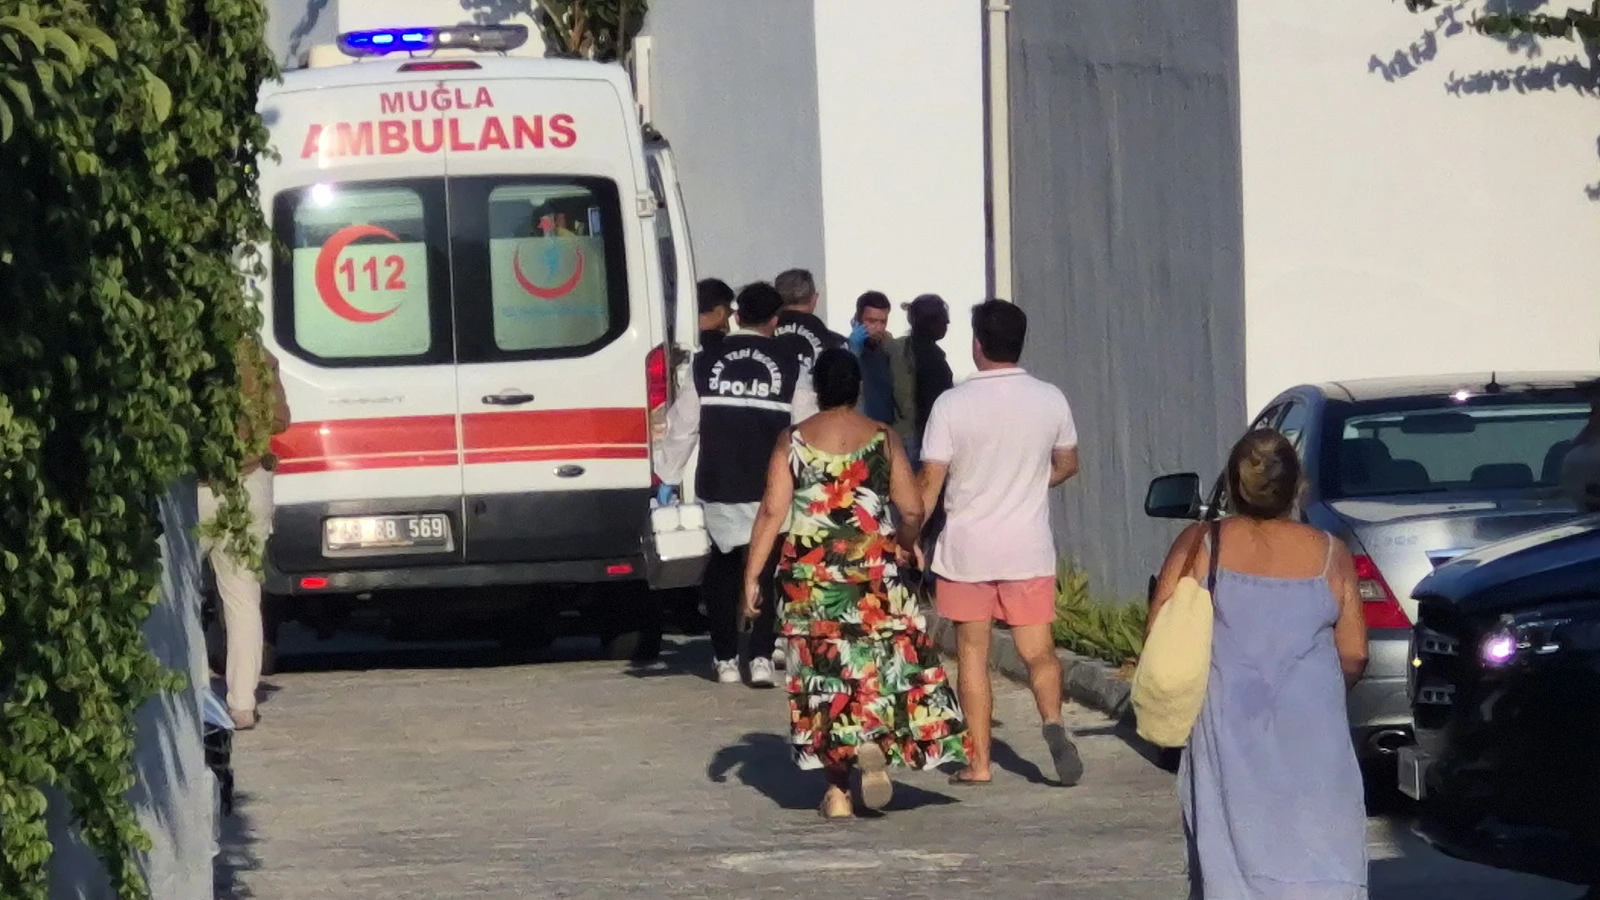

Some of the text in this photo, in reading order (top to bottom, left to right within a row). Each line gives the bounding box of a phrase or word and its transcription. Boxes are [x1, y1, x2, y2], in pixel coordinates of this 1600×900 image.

[379, 82, 494, 114] MUĞLA
[300, 113, 577, 159] AMBULANS
[339, 254, 406, 292] 112
[408, 518, 443, 538] 569
